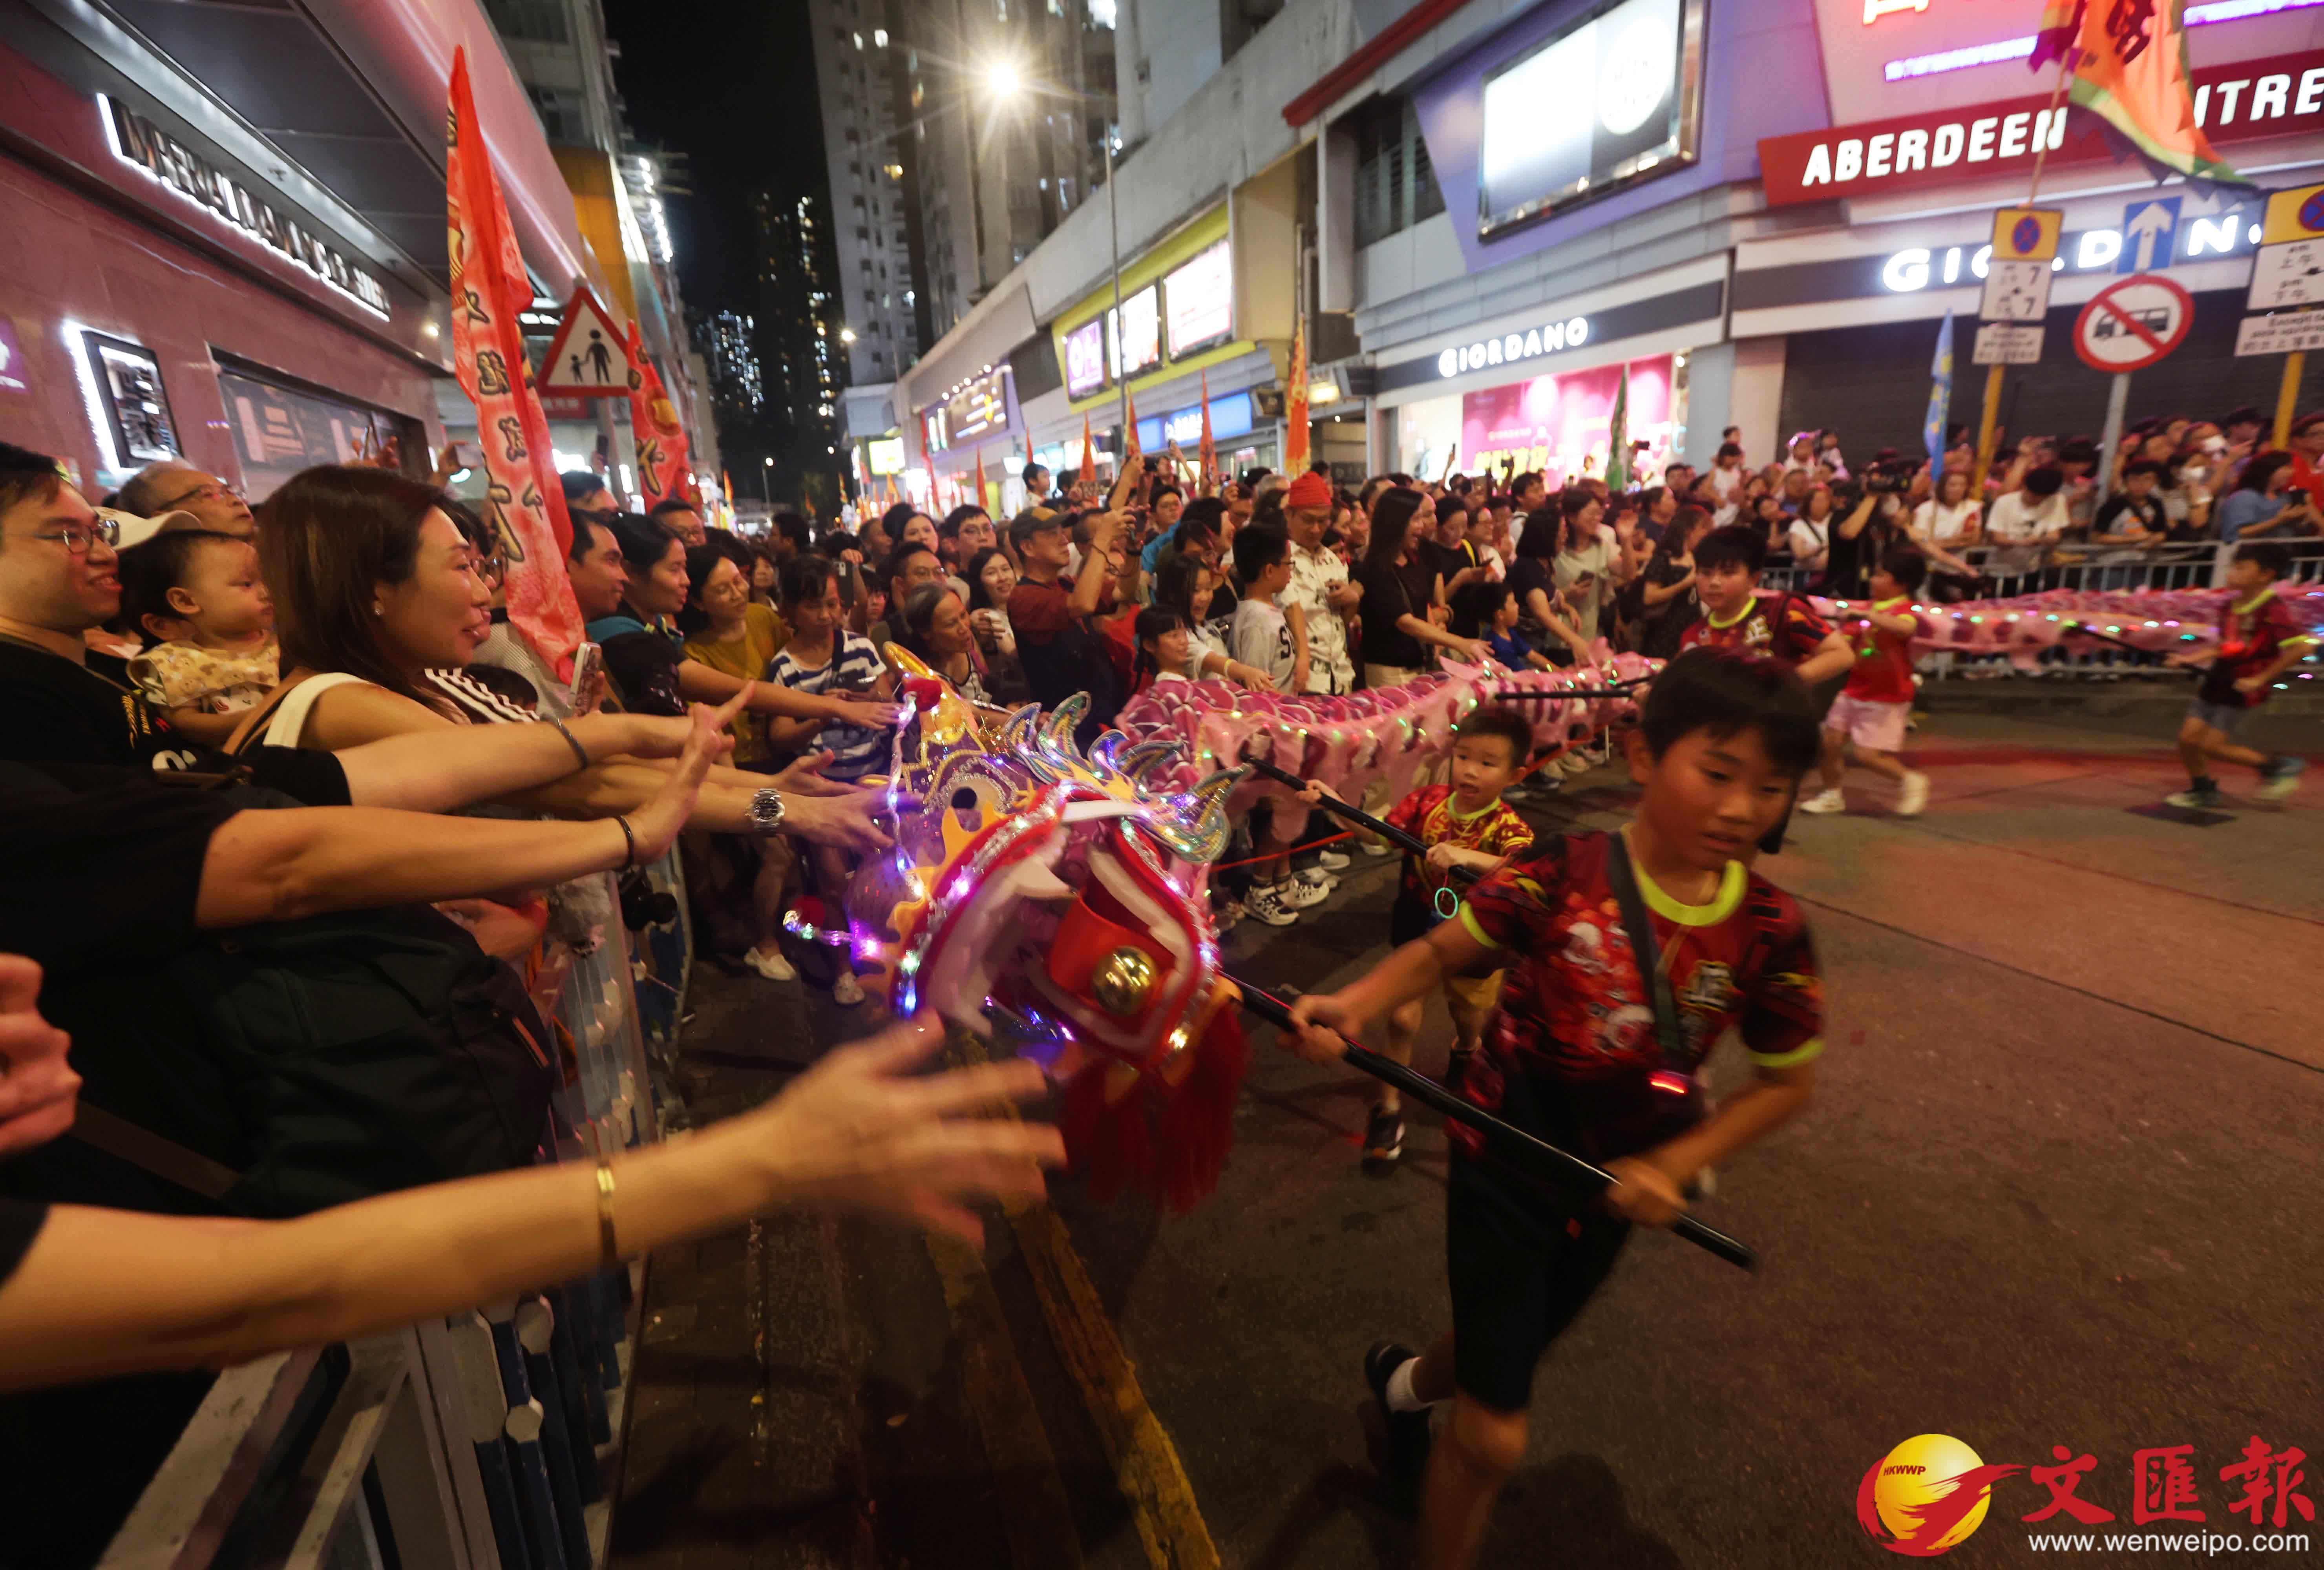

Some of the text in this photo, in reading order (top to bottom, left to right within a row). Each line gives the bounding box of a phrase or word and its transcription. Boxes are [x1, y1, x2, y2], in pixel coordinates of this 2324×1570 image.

[1801, 67, 2324, 187] ABERDEEN TRE
[2029, 265, 2041, 285] 7
[2024, 297, 2036, 315] 7
[1438, 317, 1588, 378] GIORDANO
